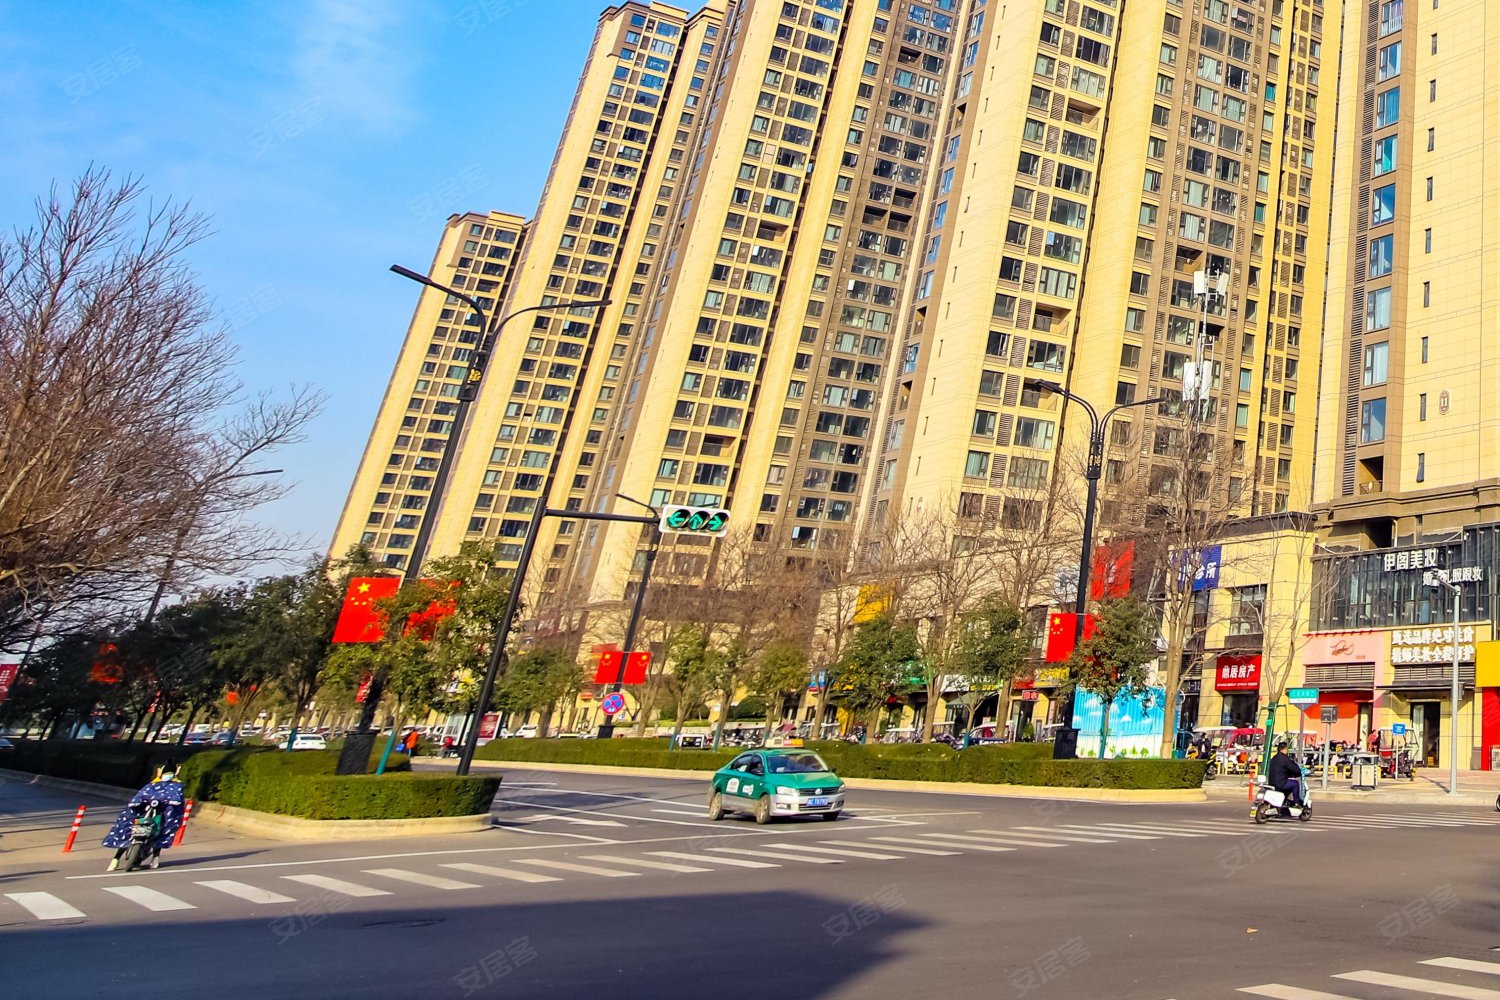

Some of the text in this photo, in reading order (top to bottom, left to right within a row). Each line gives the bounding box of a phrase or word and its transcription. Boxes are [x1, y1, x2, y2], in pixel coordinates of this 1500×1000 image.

[1423, 566, 1483, 586] 婚礼服跟妆
